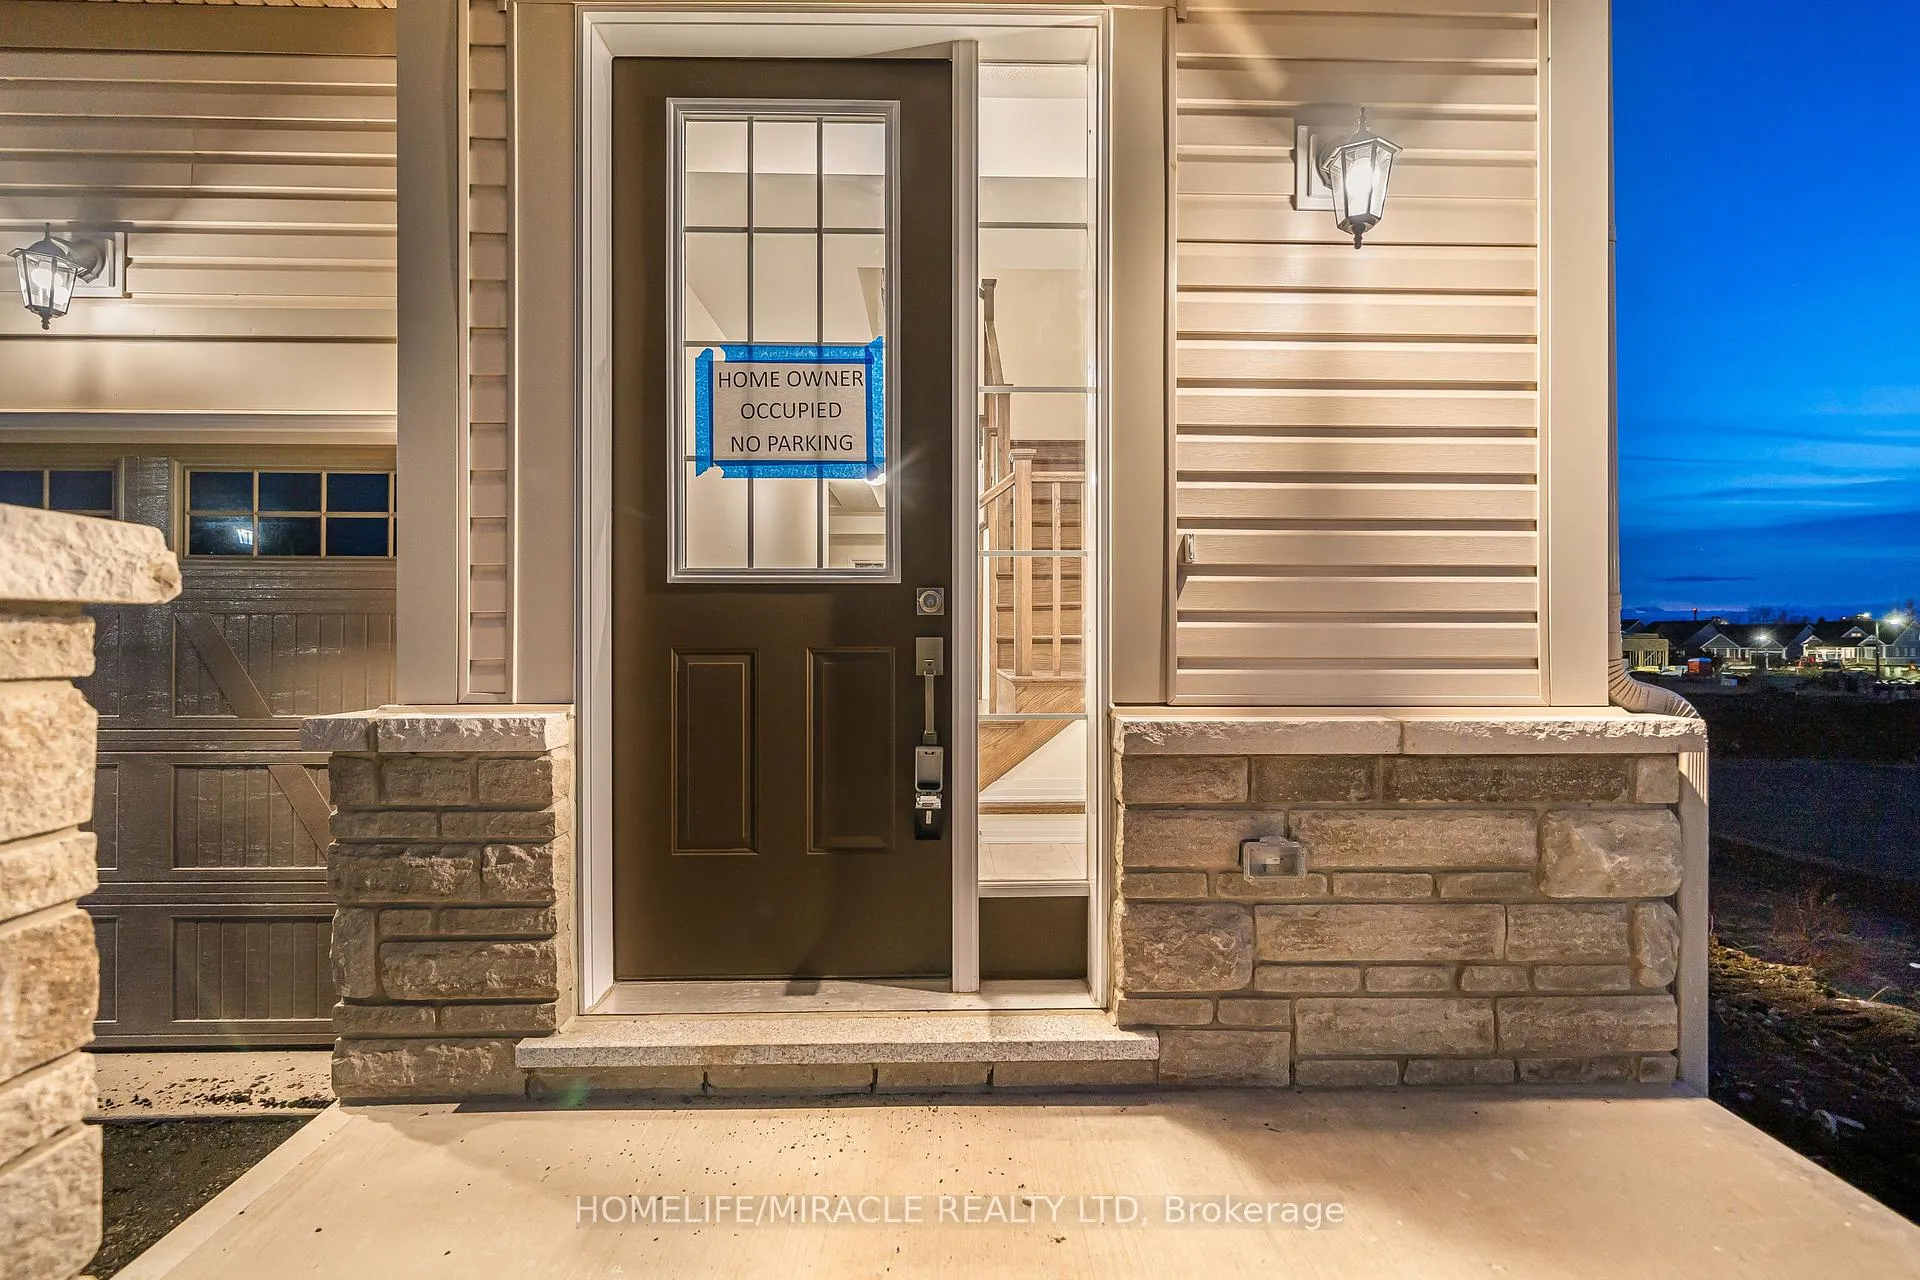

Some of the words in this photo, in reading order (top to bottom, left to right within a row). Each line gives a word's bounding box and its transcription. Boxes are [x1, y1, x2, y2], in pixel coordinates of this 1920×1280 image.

[718, 371, 780, 388] HOME
[787, 370, 864, 387] OWNER
[740, 402, 842, 419] OCCUPIED
[731, 435, 761, 452] NO
[768, 434, 853, 452] PARKING
